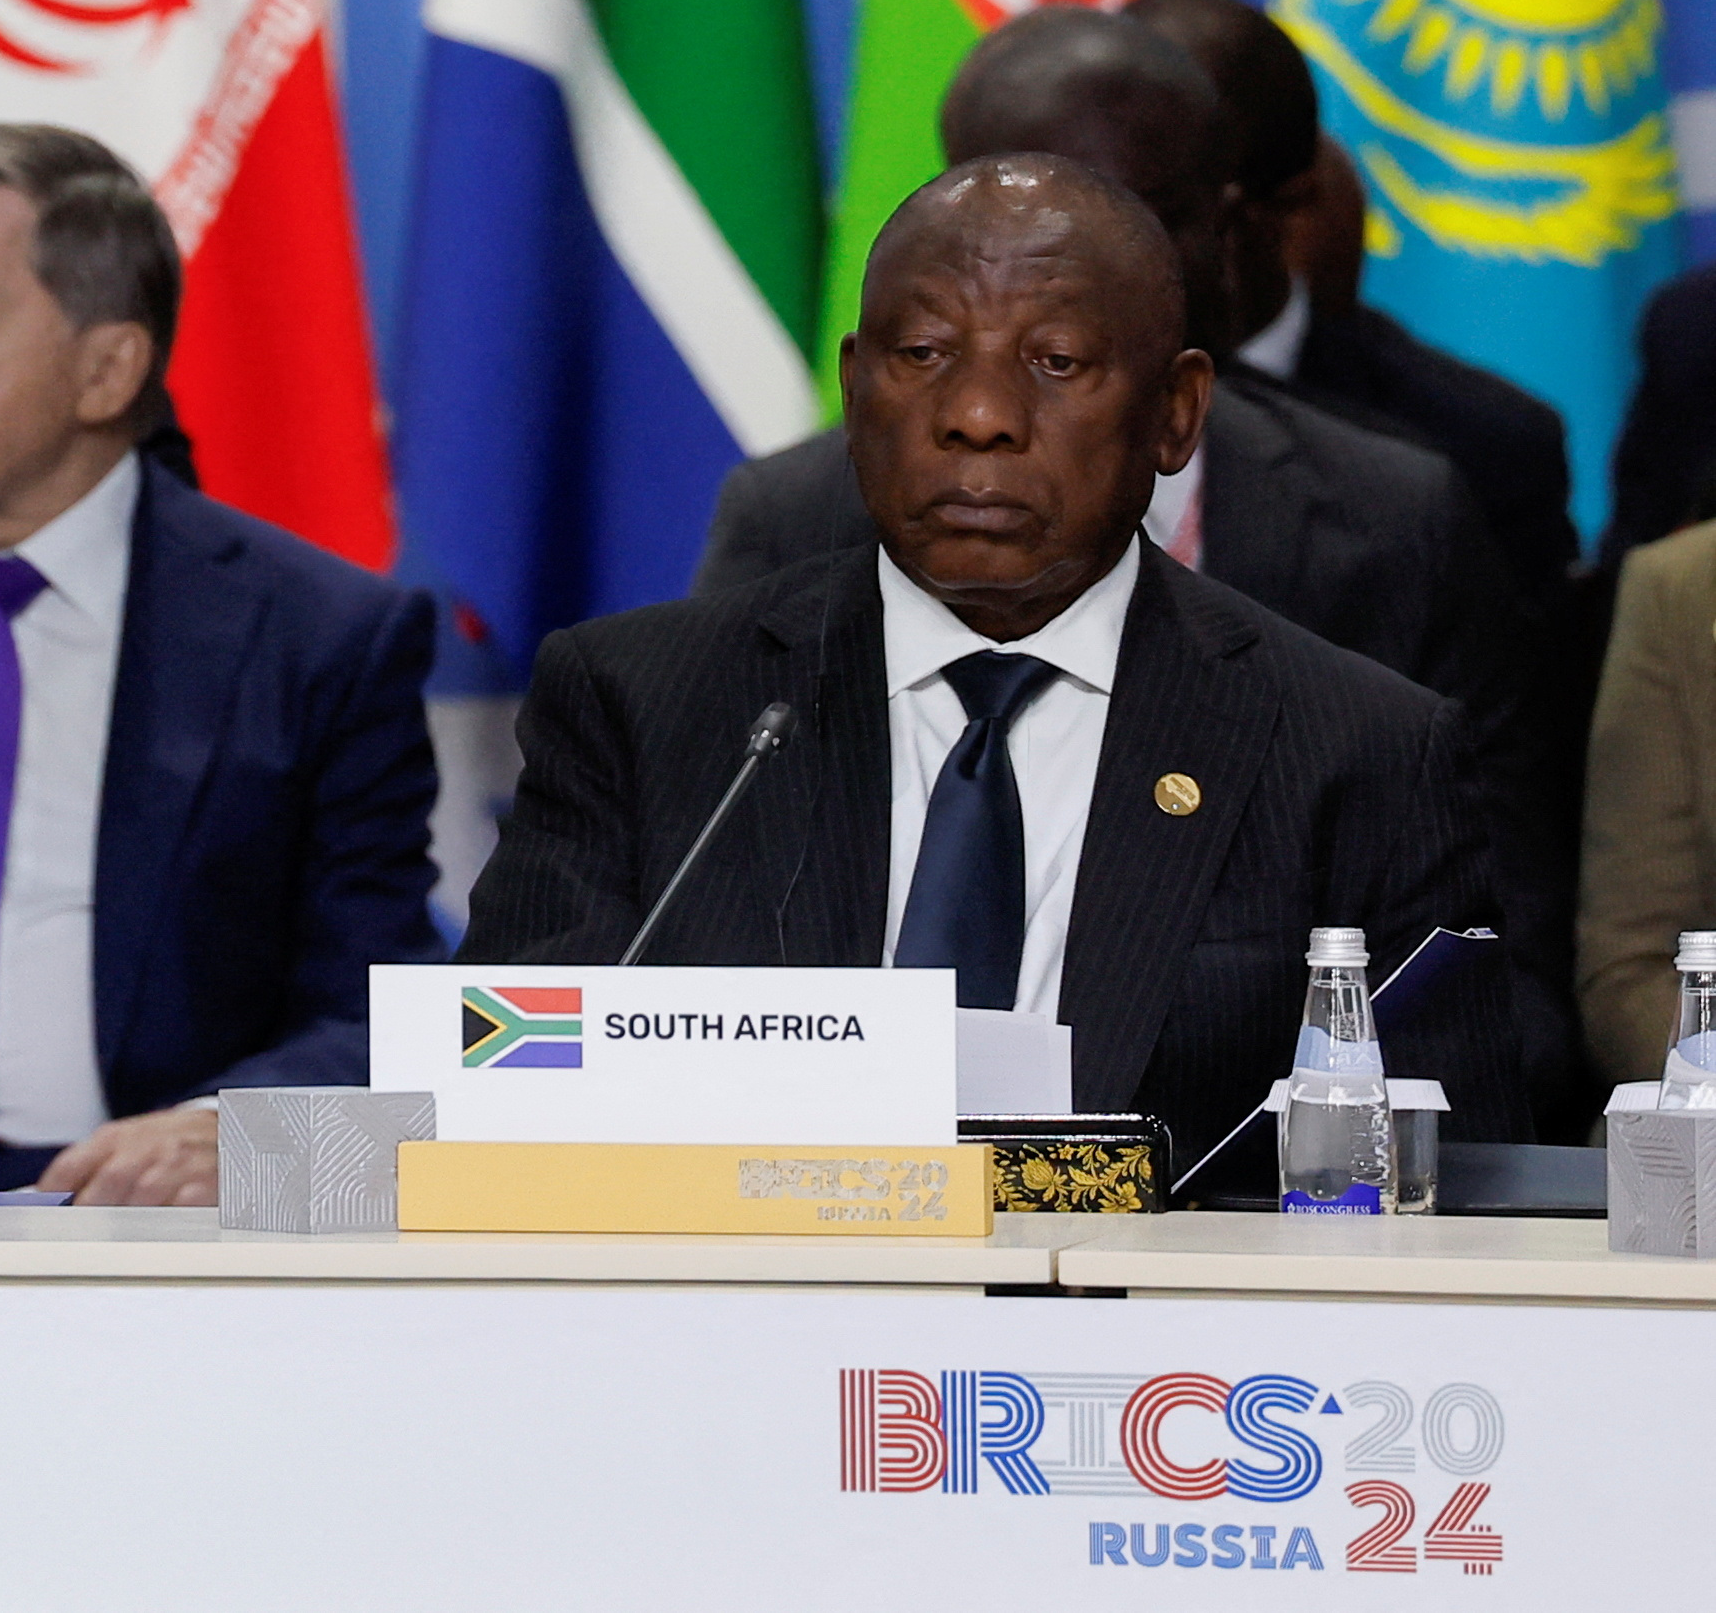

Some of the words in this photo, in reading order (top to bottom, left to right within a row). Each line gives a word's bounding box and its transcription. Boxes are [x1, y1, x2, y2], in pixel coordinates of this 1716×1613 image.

[604, 1013, 724, 1040] SOUTH
[733, 1014, 865, 1041] AFRICA
[738, 1158, 891, 1200] BRICS
[897, 1159, 949, 1191] 20
[897, 1191, 948, 1222] 24
[838, 1368, 1323, 1503] BRICS
[1341, 1379, 1505, 1476] 20
[1088, 1520, 1325, 1571] RUSSIA
[1343, 1479, 1504, 1575] 24
